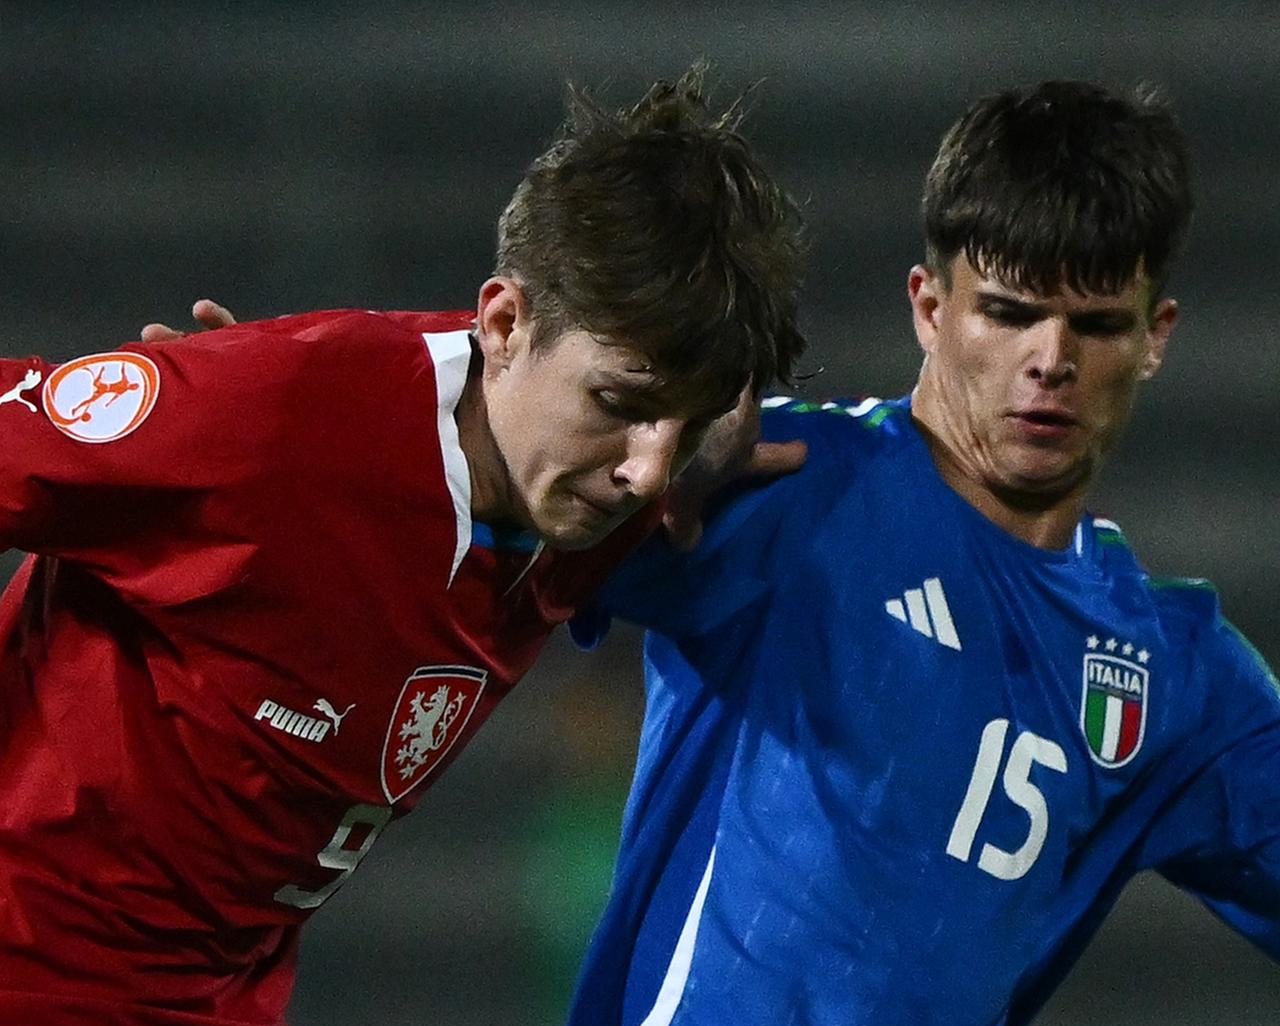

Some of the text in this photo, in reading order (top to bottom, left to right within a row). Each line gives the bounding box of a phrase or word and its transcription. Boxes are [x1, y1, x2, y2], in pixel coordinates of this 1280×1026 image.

[1088, 660, 1142, 695] ITALIA
[254, 698, 332, 743] PUMA
[946, 717, 1068, 881] 15
[273, 803, 393, 909] 9
